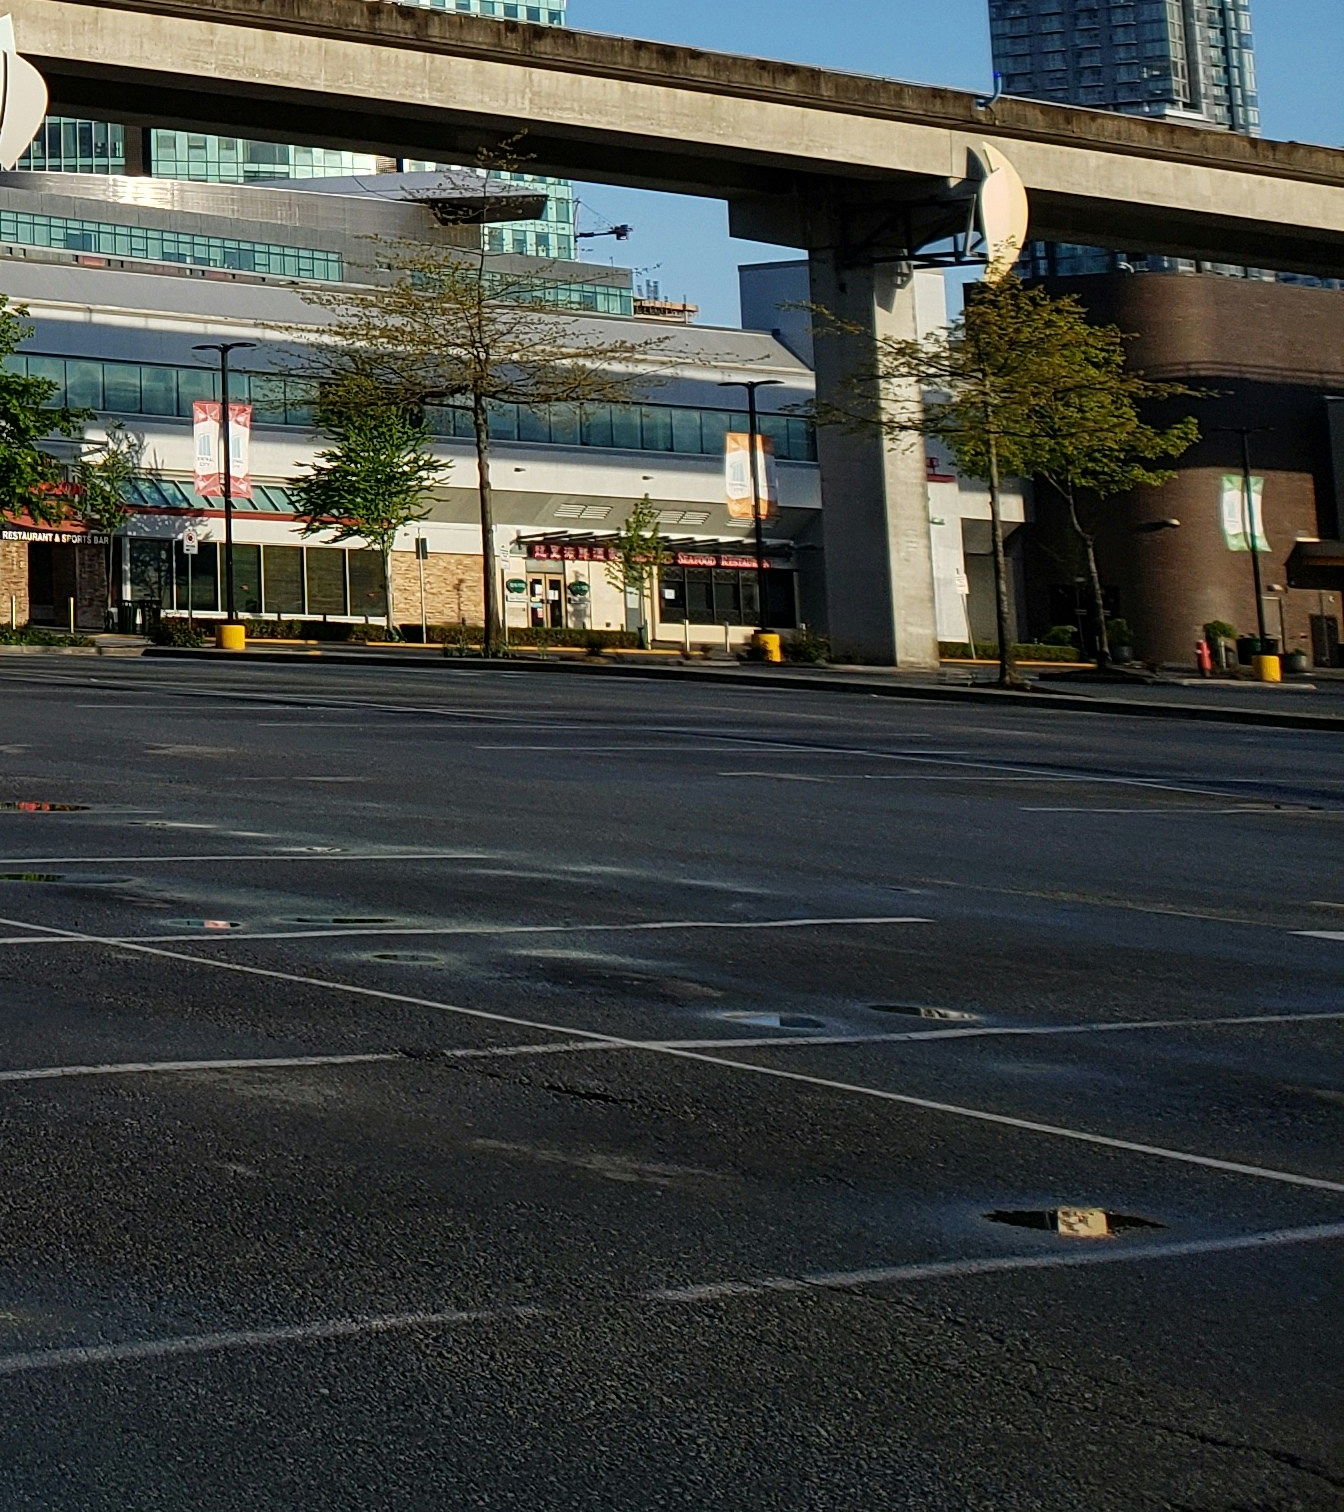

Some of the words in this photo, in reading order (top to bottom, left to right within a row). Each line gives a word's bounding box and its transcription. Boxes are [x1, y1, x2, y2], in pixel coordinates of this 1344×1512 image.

[2, 530, 53, 542] RESTAURANT
[54, 534, 60, 542] &
[61, 534, 92, 544] SPORTS
[93, 536, 110, 544] BAR
[677, 552, 716, 566] SEAFOOD
